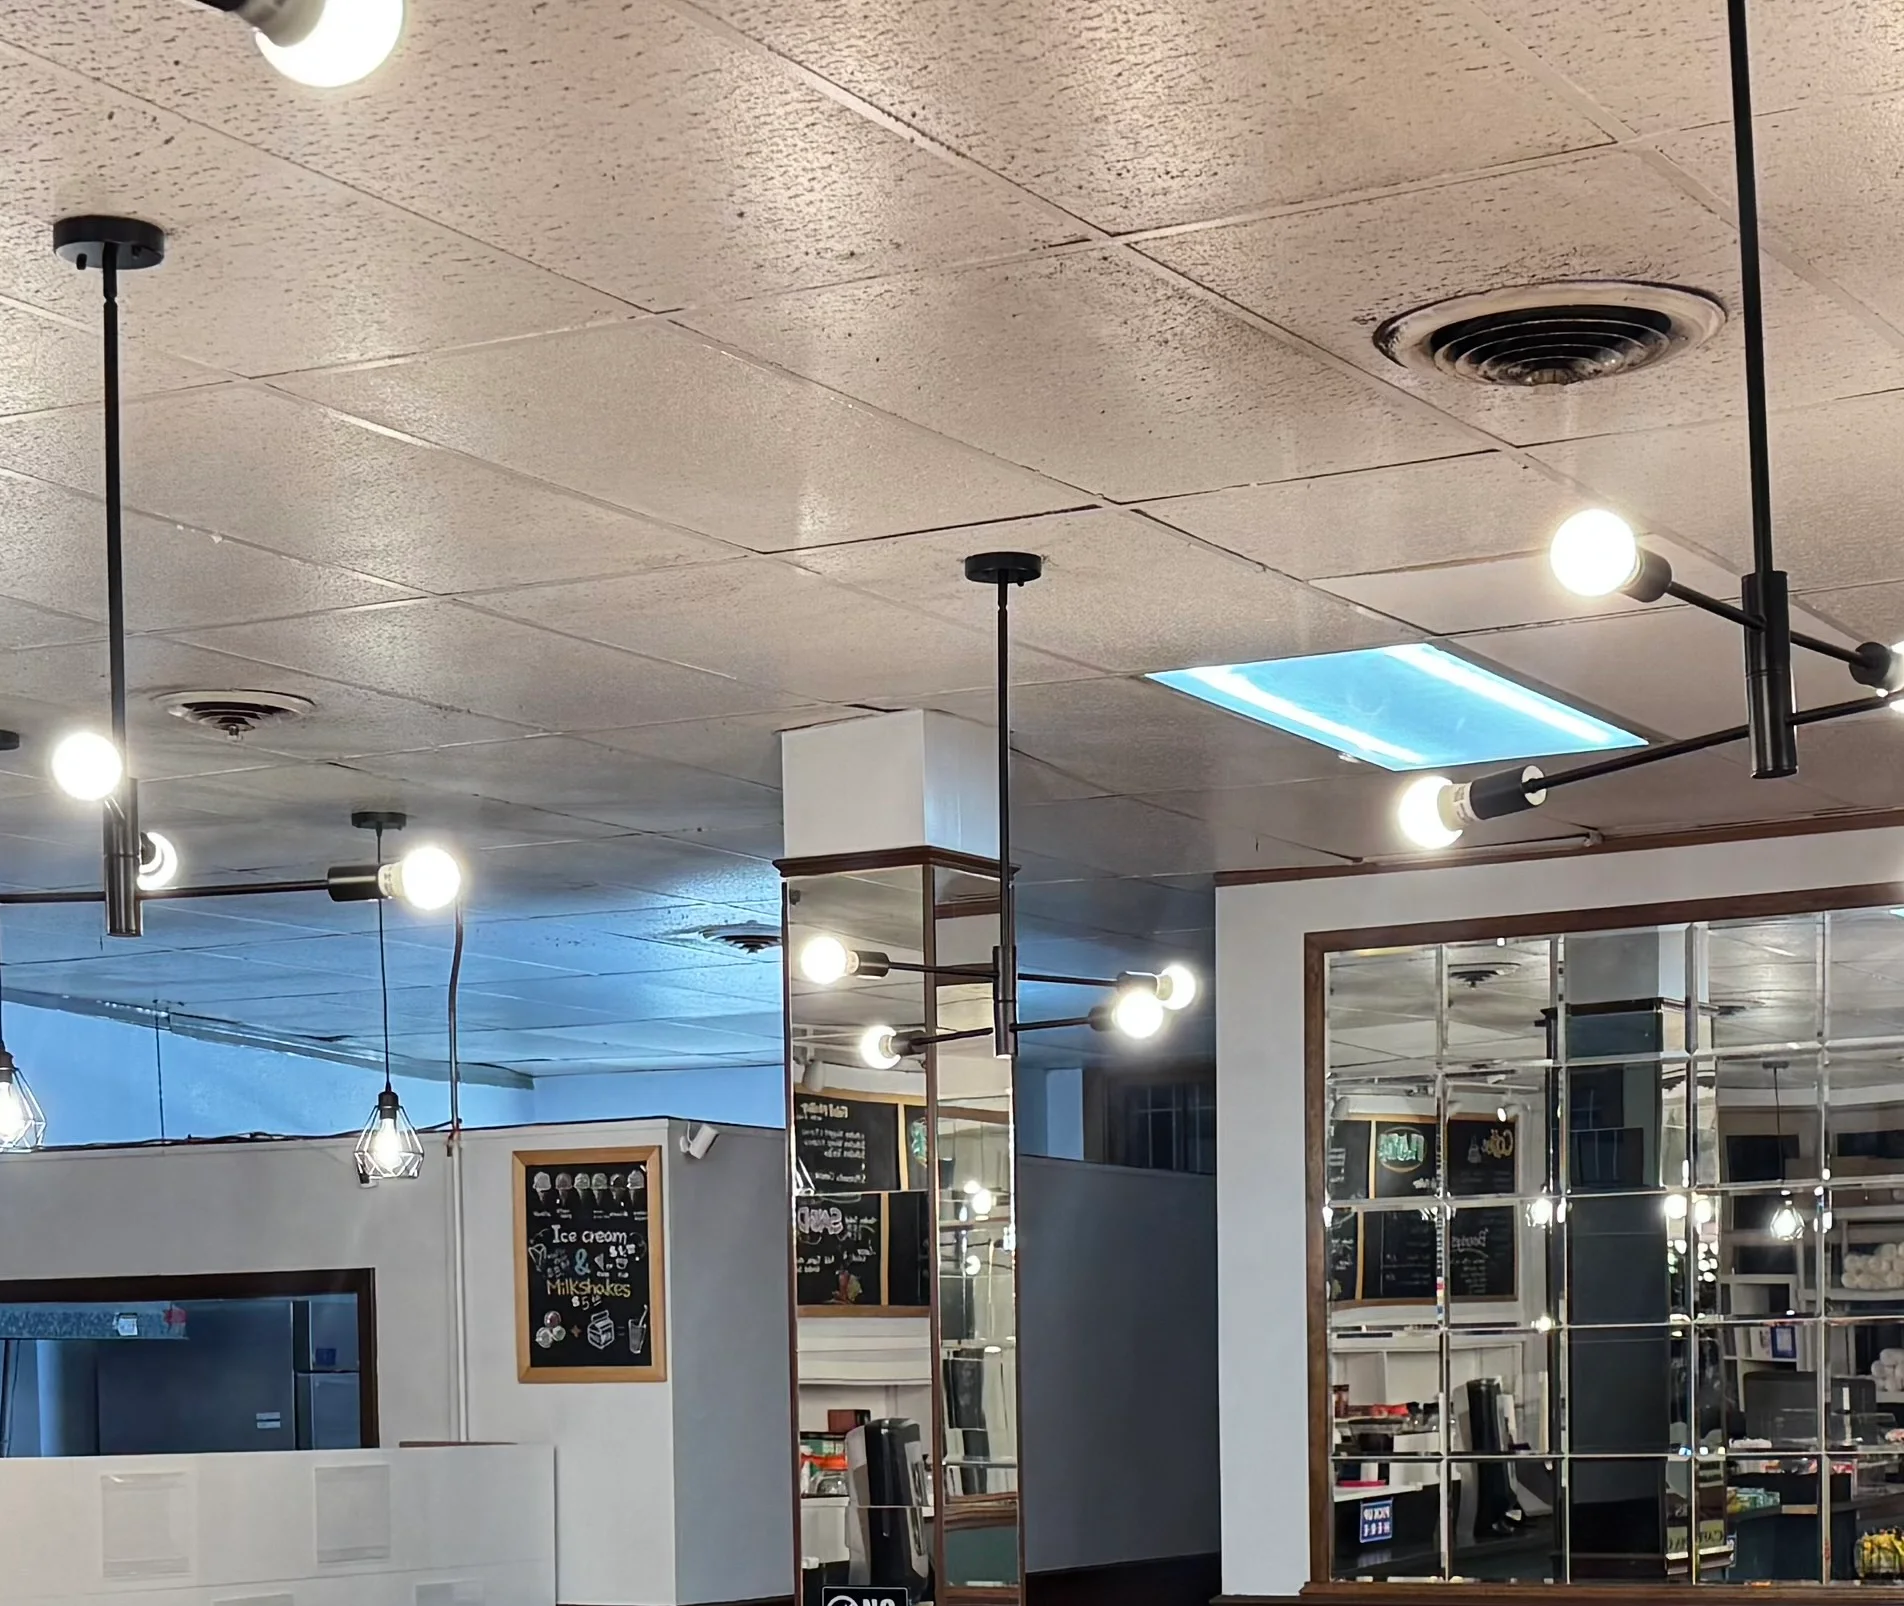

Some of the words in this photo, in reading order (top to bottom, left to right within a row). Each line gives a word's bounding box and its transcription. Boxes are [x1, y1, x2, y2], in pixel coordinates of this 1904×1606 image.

[551, 1224, 577, 1243] Ice
[575, 1248, 591, 1276] &
[546, 1278, 631, 1298] Milkshakes
